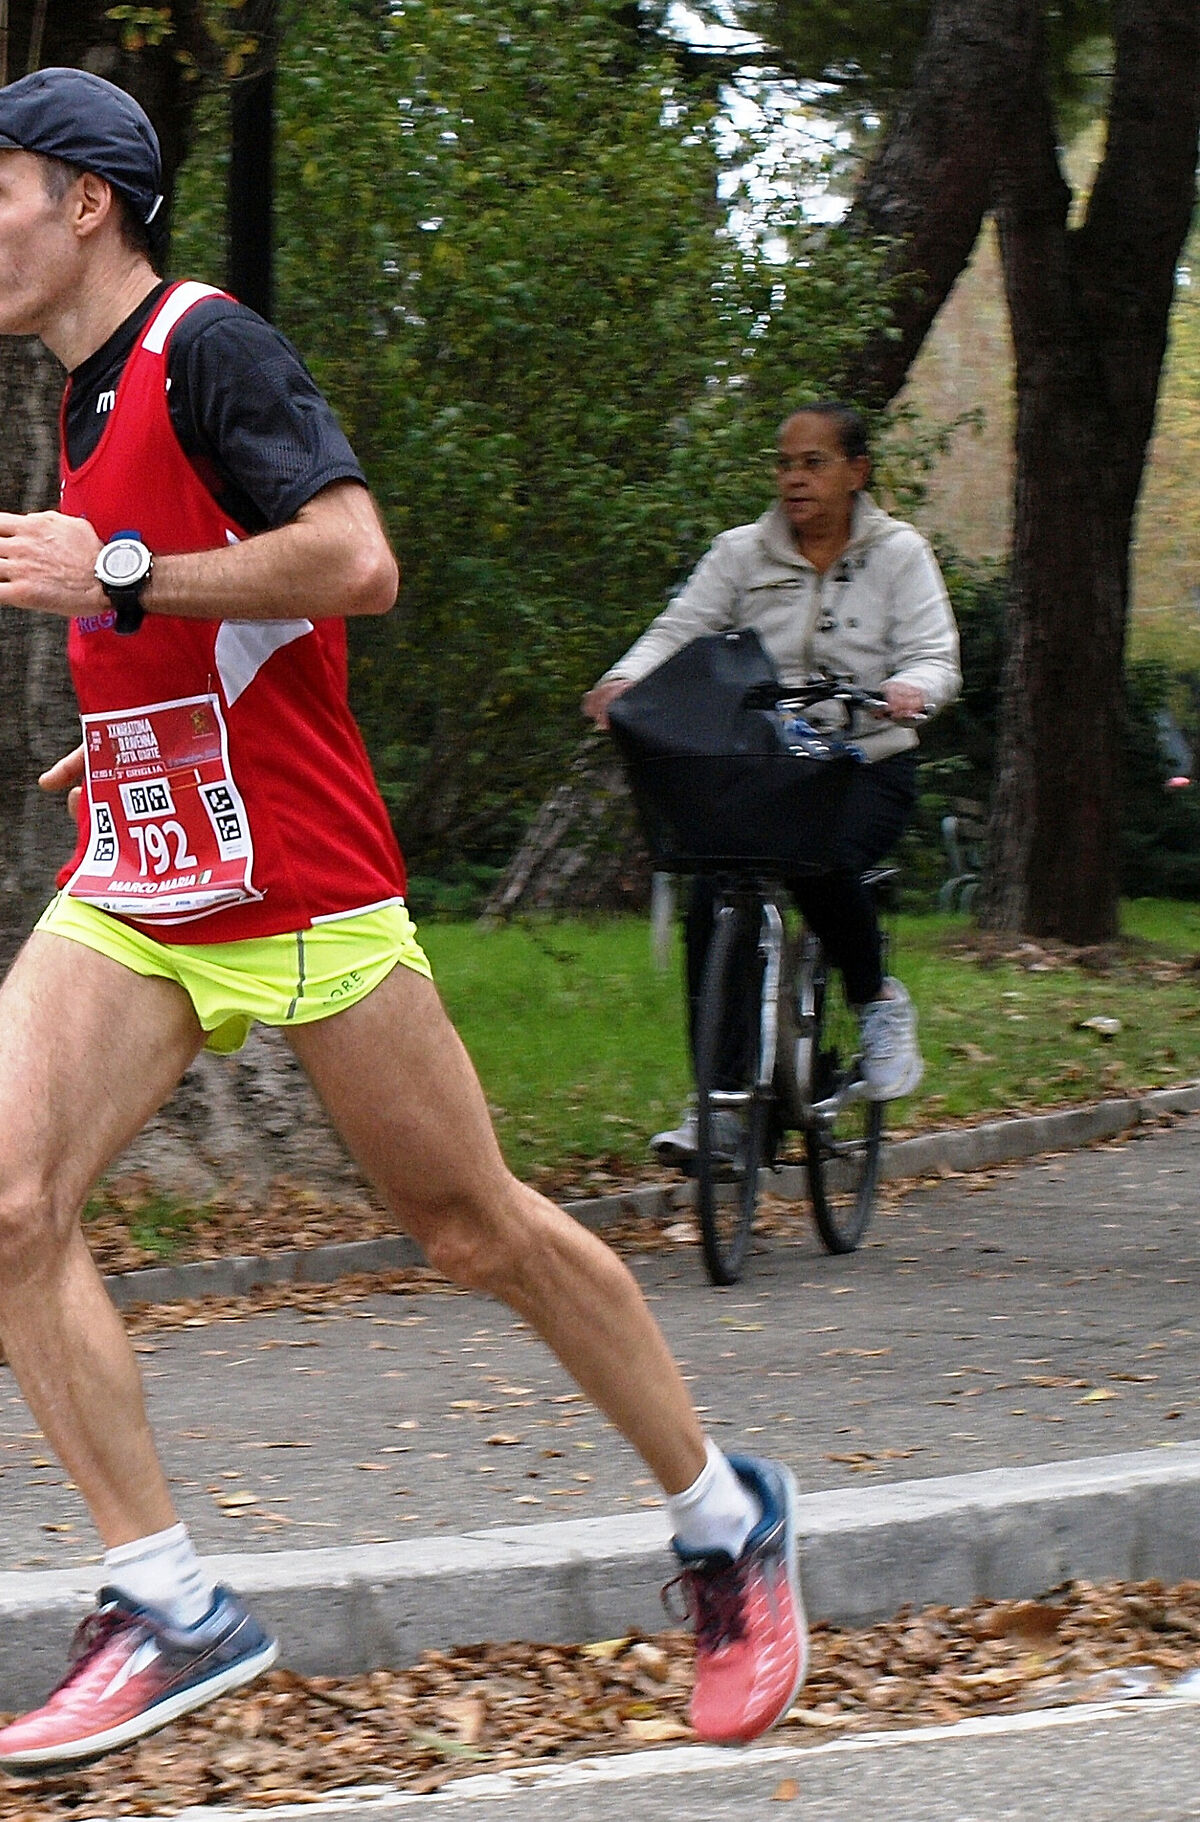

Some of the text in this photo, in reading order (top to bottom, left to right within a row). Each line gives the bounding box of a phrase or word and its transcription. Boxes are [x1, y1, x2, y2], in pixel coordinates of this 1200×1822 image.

[128, 821, 198, 876] 792
[107, 874, 197, 893] MARCO MARIA
